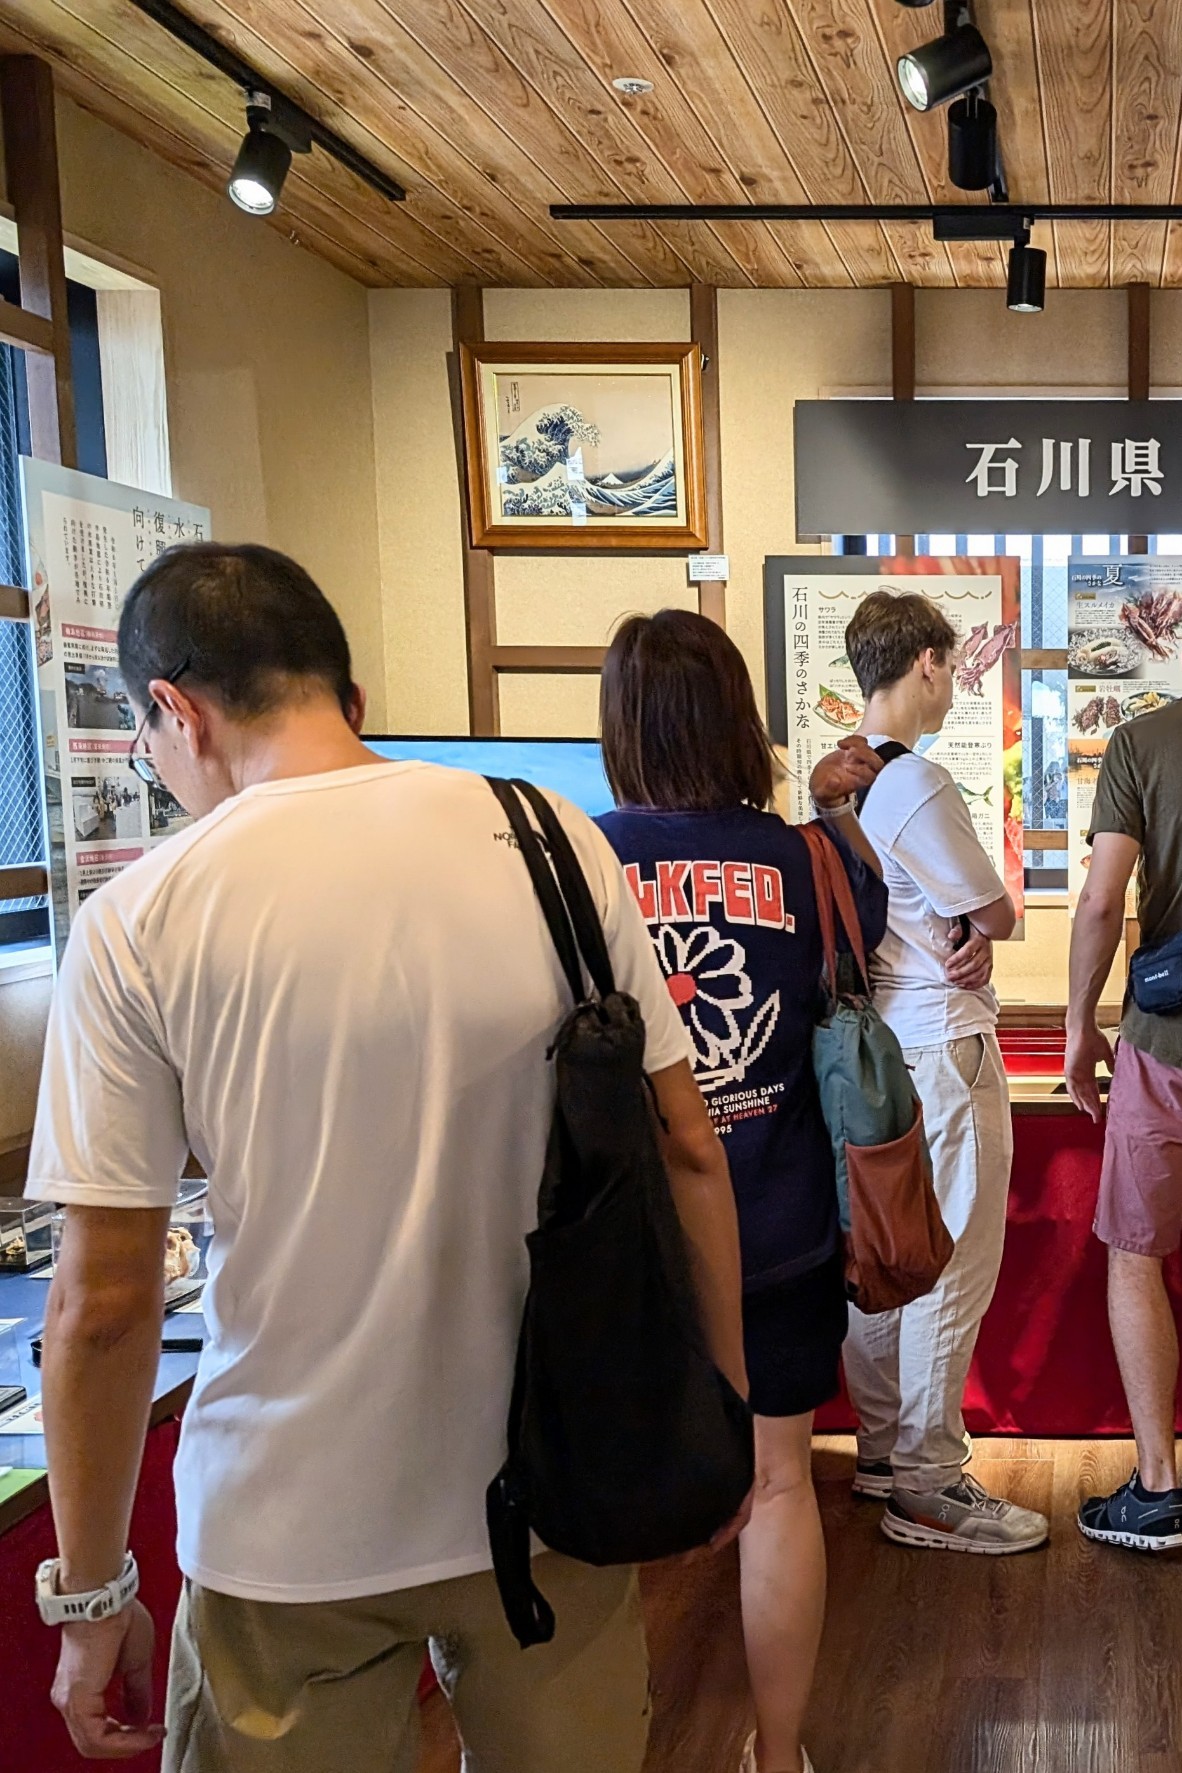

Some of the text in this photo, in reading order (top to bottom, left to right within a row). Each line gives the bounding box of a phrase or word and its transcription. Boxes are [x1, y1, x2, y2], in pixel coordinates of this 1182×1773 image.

[1102, 564, 1124, 586] 夏
[818, 606, 836, 614] サワラ
[792, 586, 811, 729] 石川の四季のさかな
[947, 741, 992, 749] 天然能登寒ぶり
[711, 1089, 758, 1106] GLORIOUS
[760, 1083, 785, 1096] DAYS
[723, 1096, 771, 1114] SUNSHINE
[733, 1107, 765, 1121] HEAVEN
